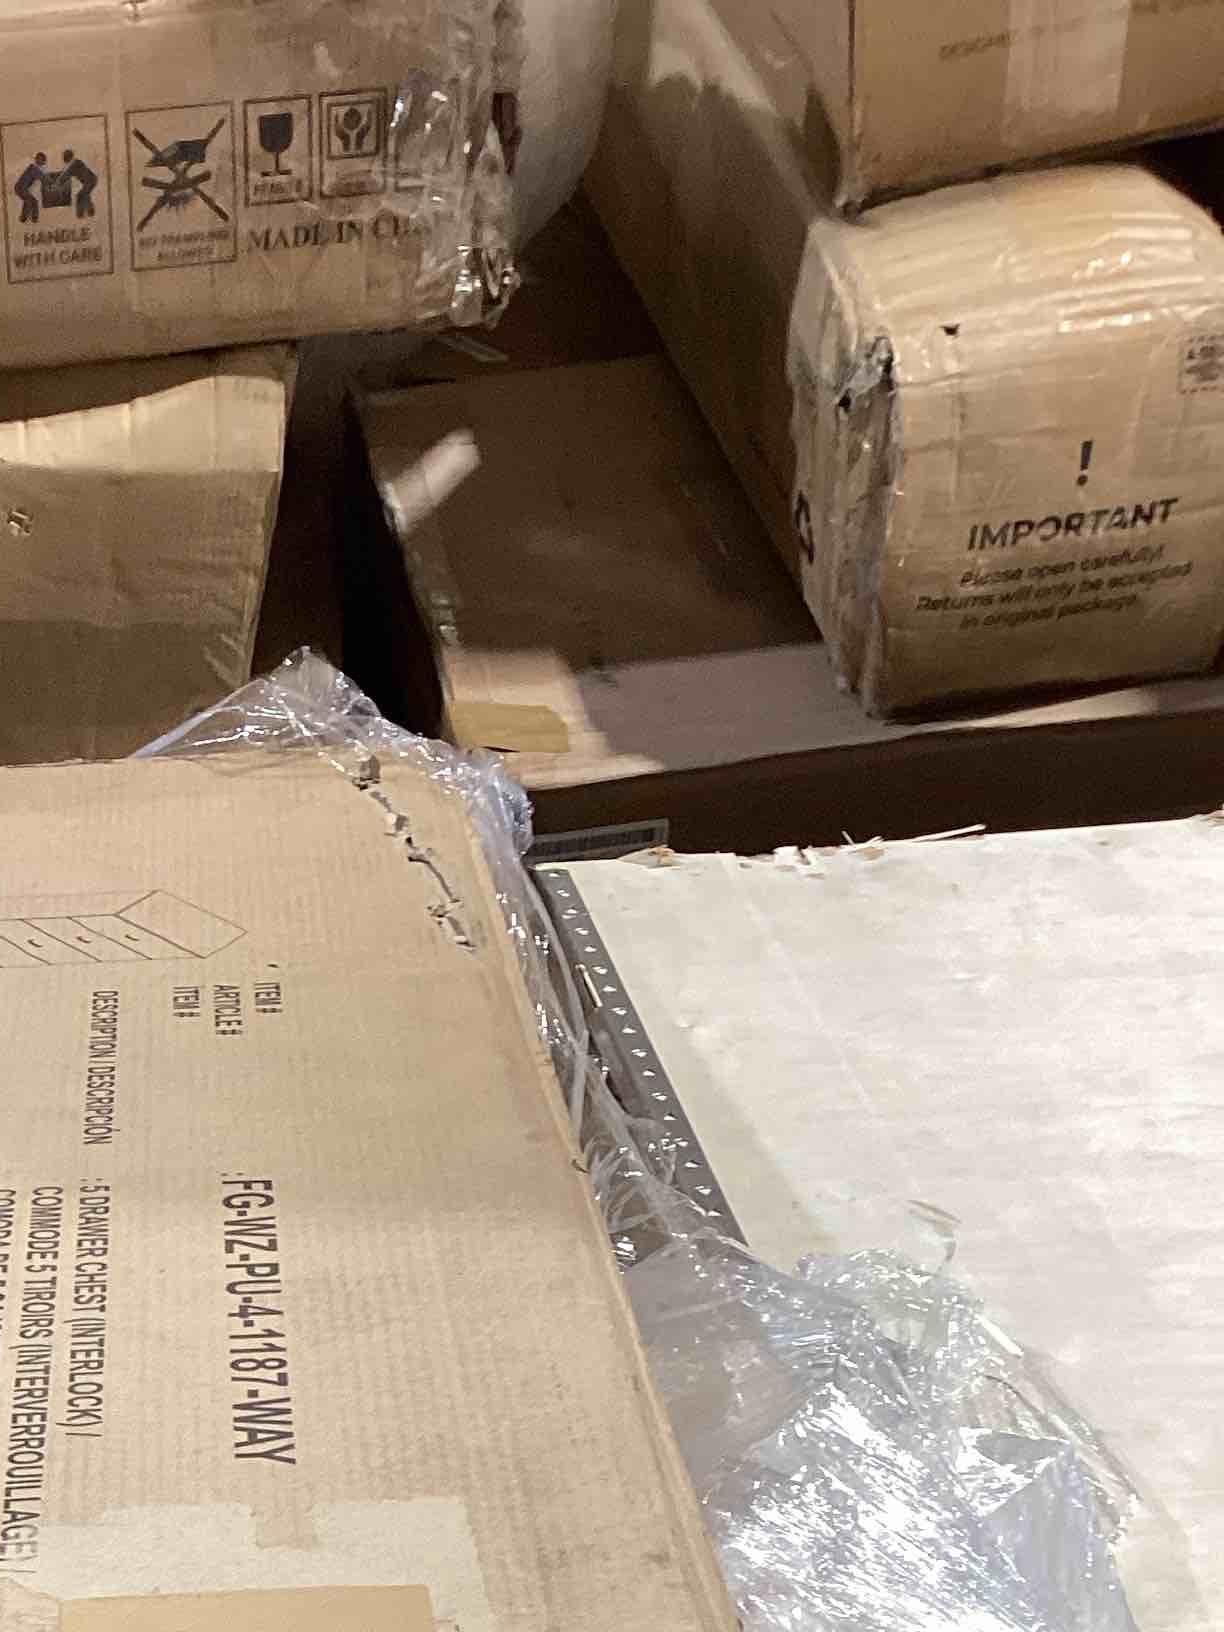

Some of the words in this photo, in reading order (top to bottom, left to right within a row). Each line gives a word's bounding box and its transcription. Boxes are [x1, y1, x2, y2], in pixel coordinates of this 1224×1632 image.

[966, 497, 1179, 552] IMPORTANT
[88, 990, 119, 1058] DESCRIPTION
[213, 984, 242, 1027] ARTICLE
[254, 982, 283, 1005] ITEM
[82, 1066, 119, 1145] DESCRIPCIÓN
[27, 1186, 64, 1259] COMMODE
[75, 1196, 110, 1259] DRAWER
[19, 1276, 57, 1339] TIROIRS
[71, 1262, 107, 1313] CHEST
[221, 1179, 296, 1465] FG-WZ-PU-4-1187-WAY
[57, 1318, 106, 1426] (INTERLOCK)
